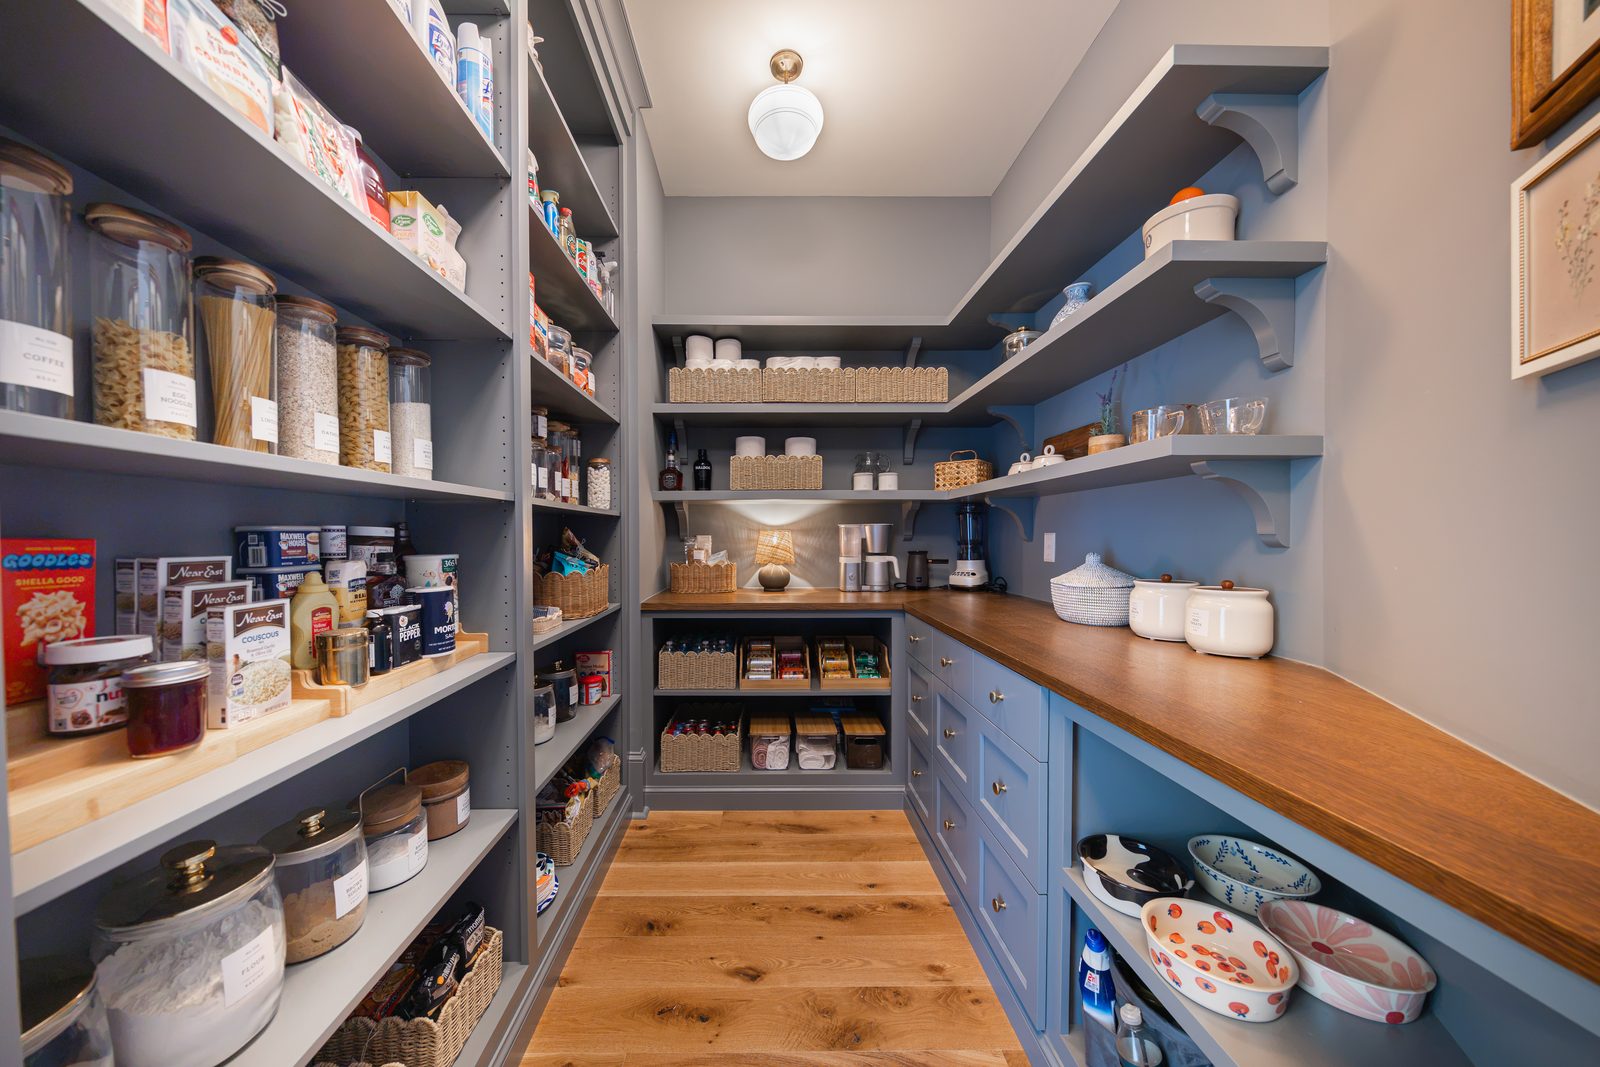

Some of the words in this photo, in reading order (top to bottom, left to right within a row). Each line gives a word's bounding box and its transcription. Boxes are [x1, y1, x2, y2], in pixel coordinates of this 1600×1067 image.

[22, 352, 65, 368] COFFEE
[172, 392, 187, 400] EGG
[280, 532, 305, 540] MAXWELL
[289, 539, 306, 547] HOUSE
[2, 553, 94, 571] GOODLES
[443, 560, 456, 568] 365
[170, 566, 203, 580] Near
[204, 565, 224, 578] East
[277, 573, 304, 583] MAXWELL
[15, 577, 54, 586] SHELLA
[56, 575, 85, 584] GOOD
[194, 592, 225, 608] Near
[225, 591, 245, 604] East
[236, 612, 264, 627] Near
[265, 609, 283, 623] East
[399, 622, 420, 633] BLACK
[241, 631, 279, 644] COUSCOUS
[399, 627, 422, 642] PEPPER
[241, 955, 265, 976] FLOUR
